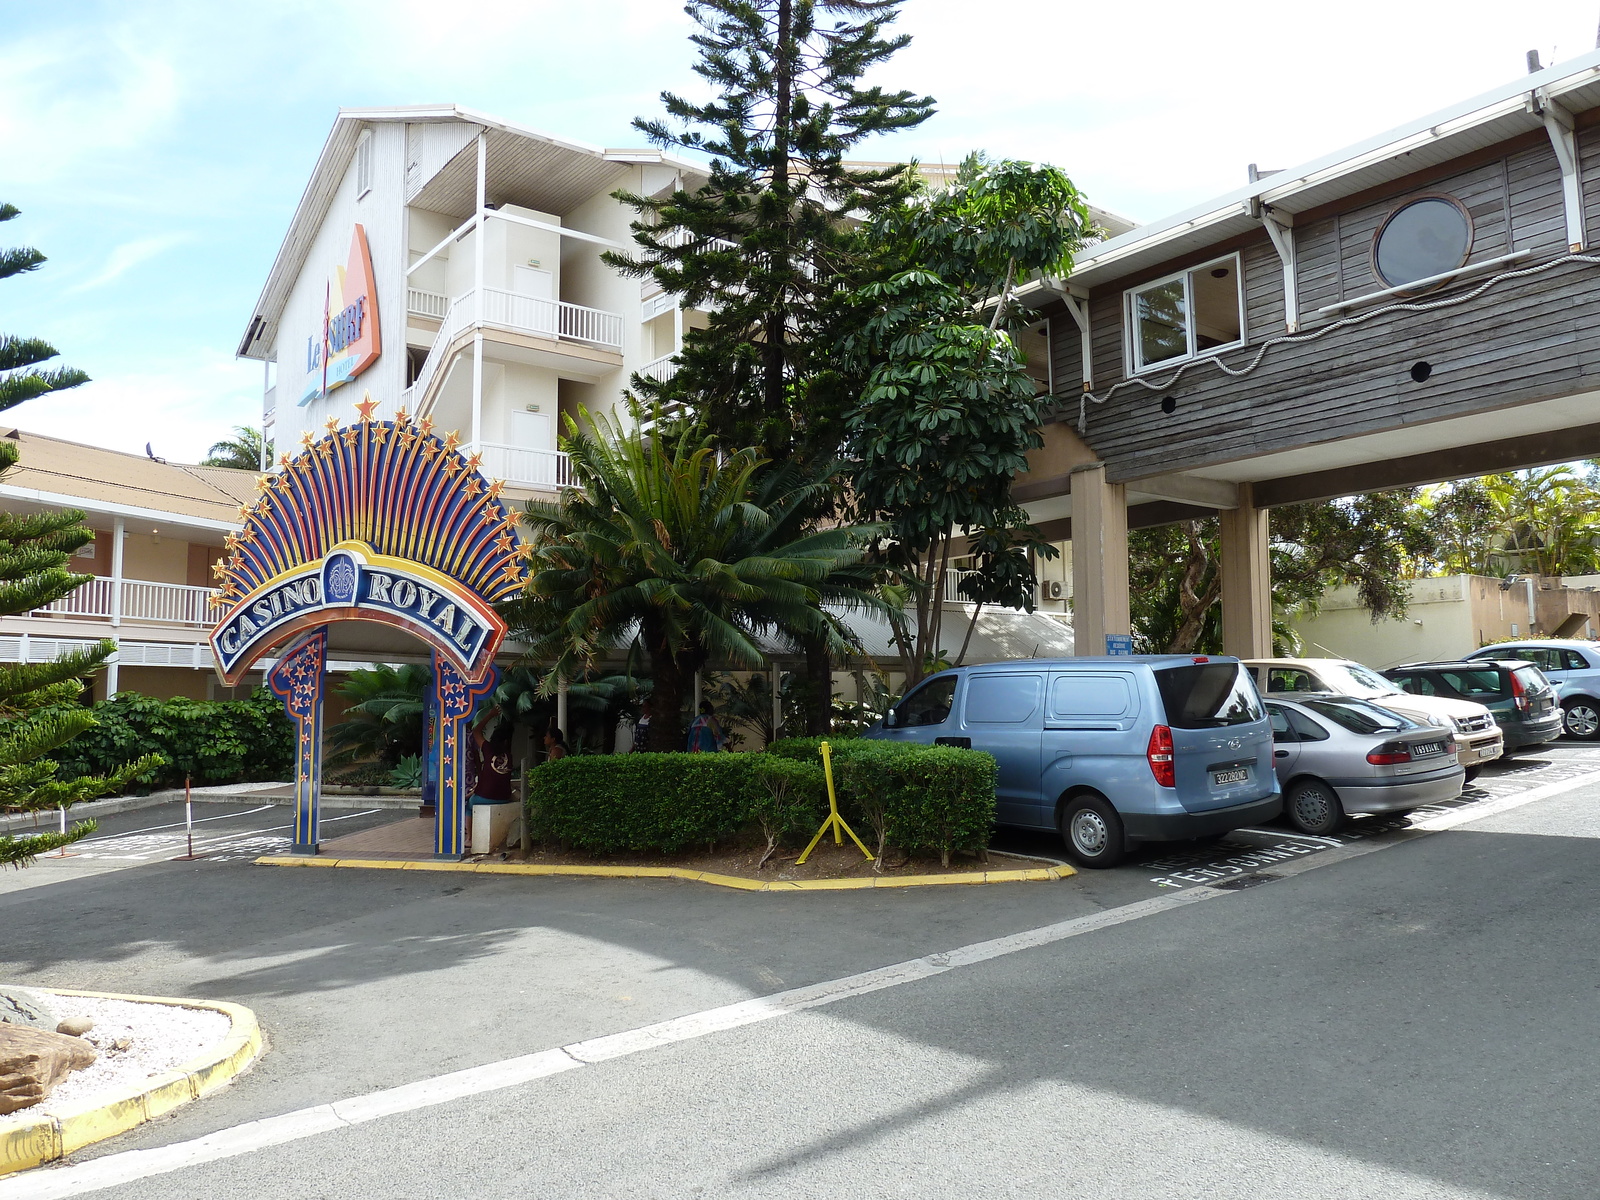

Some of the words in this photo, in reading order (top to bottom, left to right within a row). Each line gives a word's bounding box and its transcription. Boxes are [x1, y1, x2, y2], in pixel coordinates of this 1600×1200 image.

[306, 334, 321, 375] Le
[327, 295, 367, 358] SURF
[220, 577, 322, 654] CASINO
[367, 572, 477, 652] ROYAL
[1150, 838, 1327, 888] PERSONNEL
